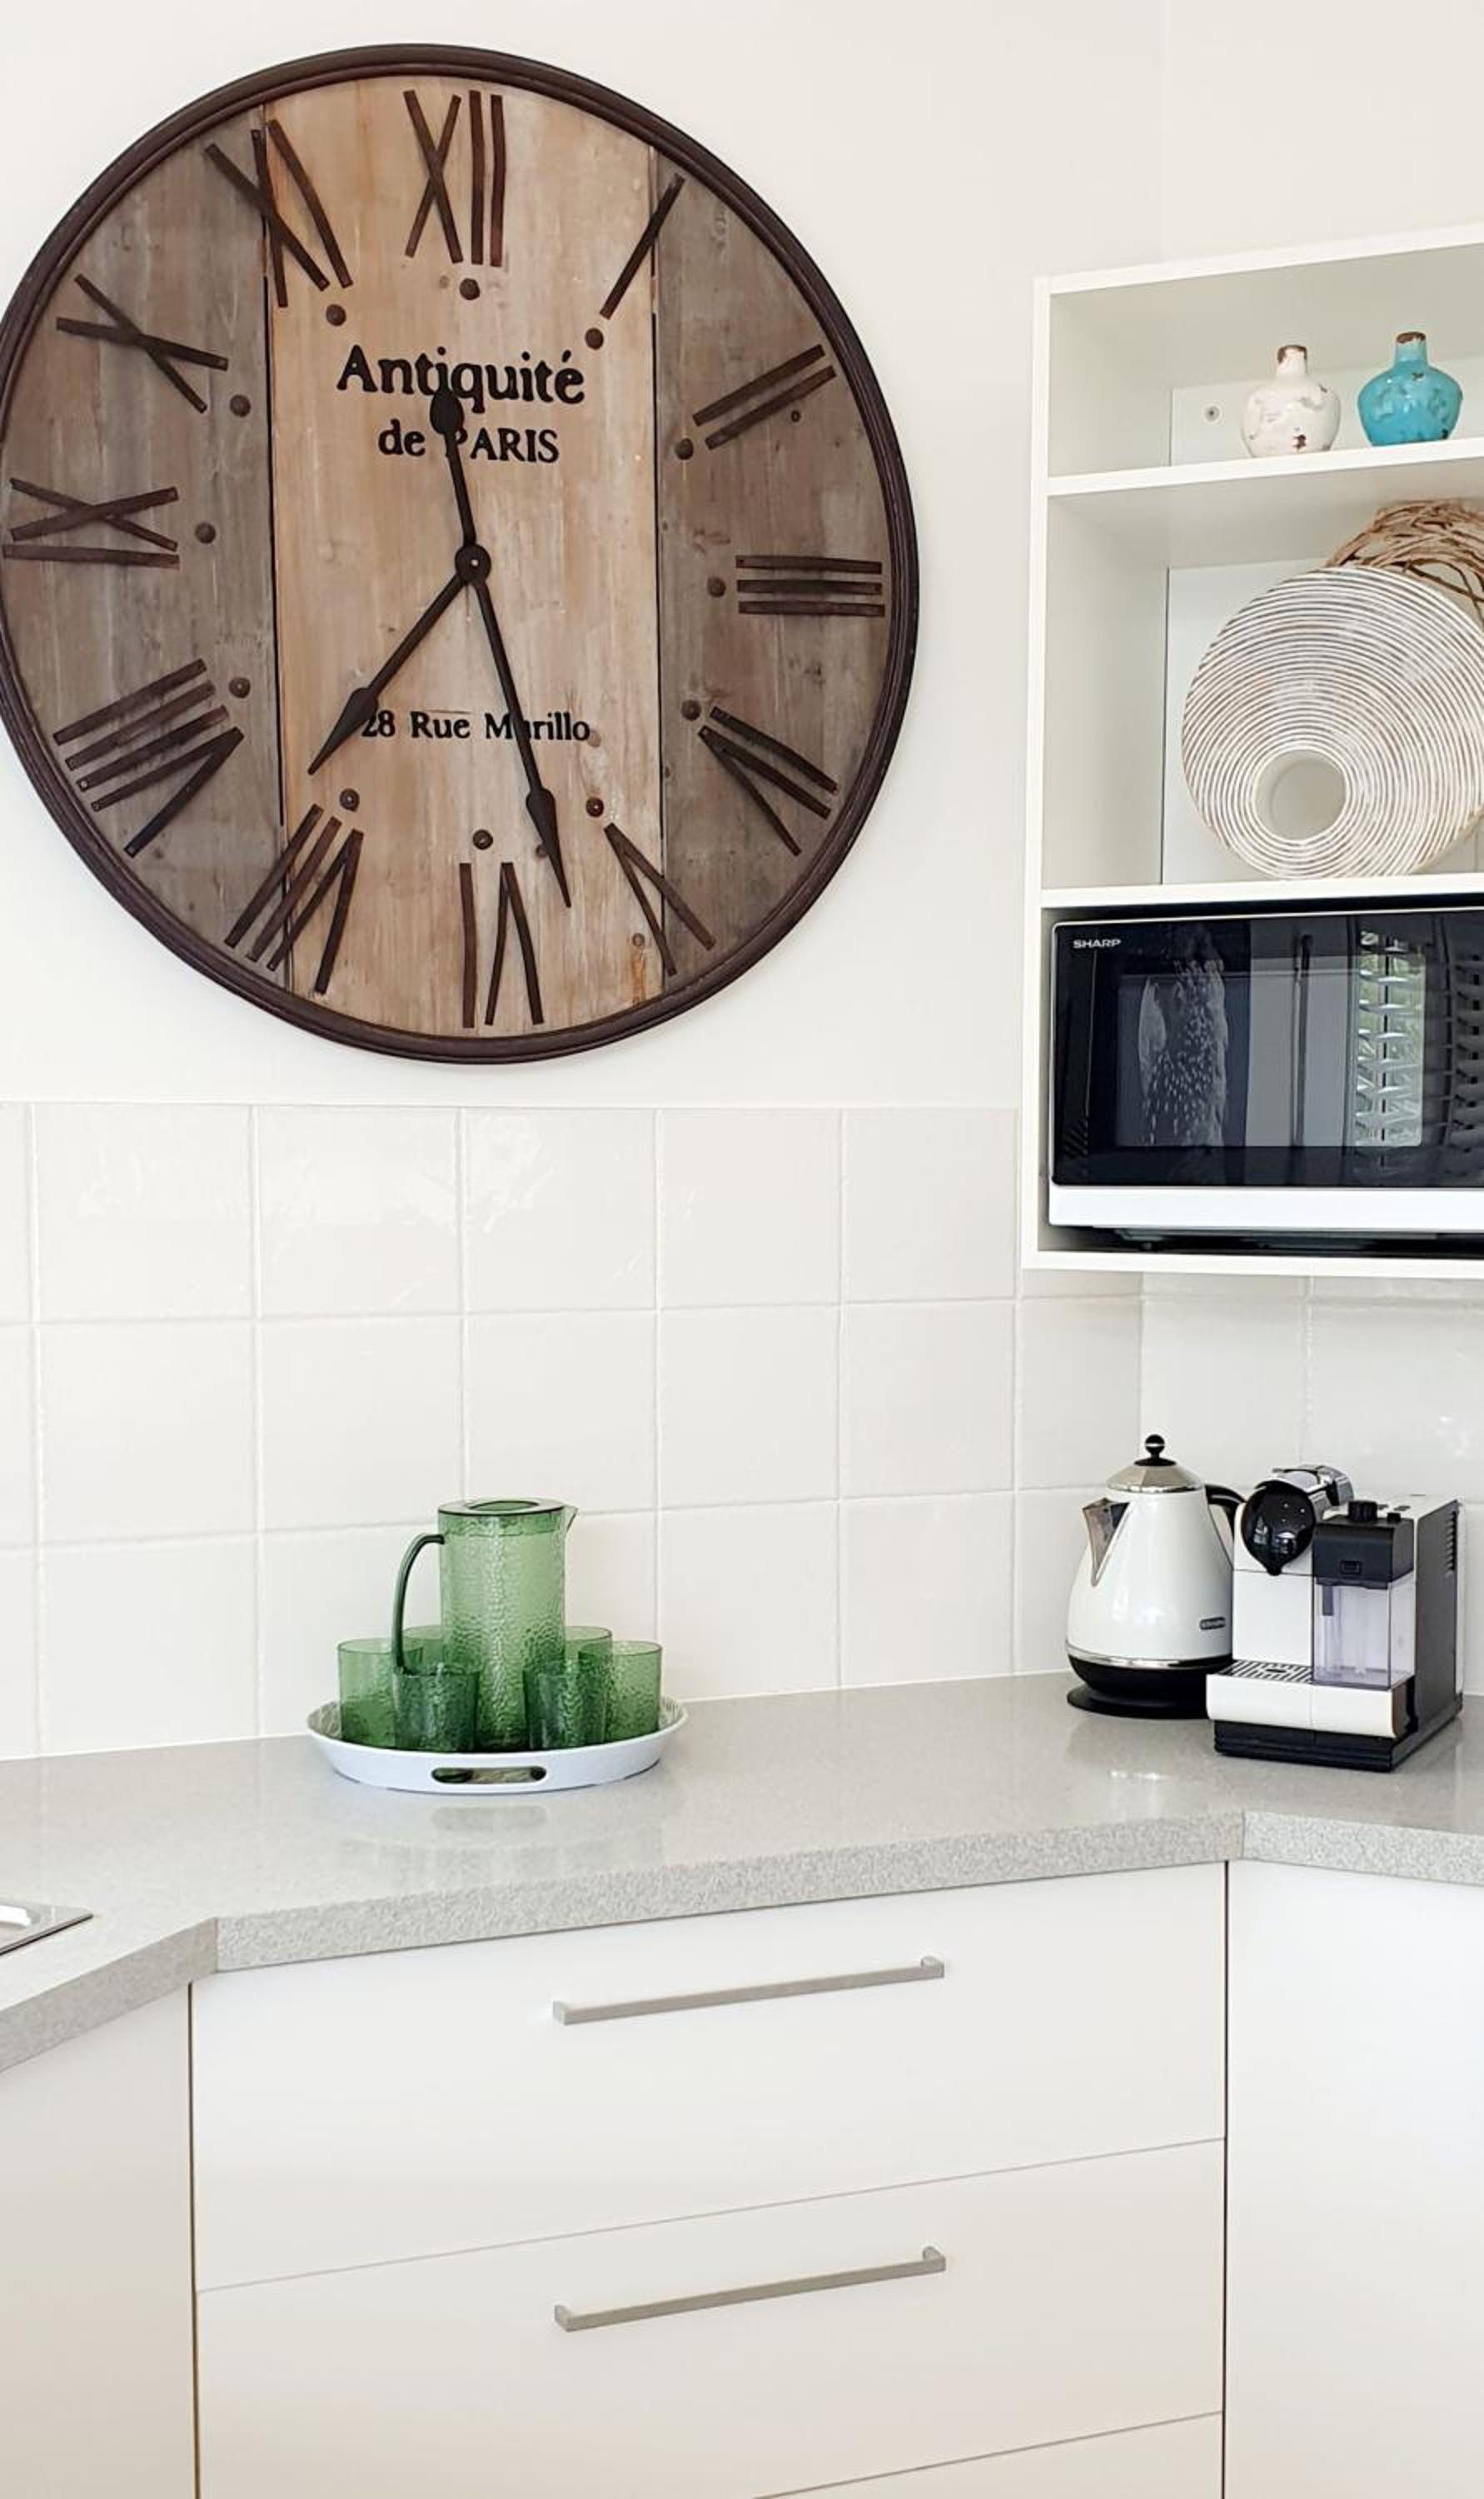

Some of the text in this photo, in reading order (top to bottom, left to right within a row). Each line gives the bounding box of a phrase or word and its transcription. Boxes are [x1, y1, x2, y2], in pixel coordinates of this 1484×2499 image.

[403, 89, 504, 267] XII
[205, 119, 353, 308] XI
[56, 274, 230, 414] X
[336, 344, 585, 414] Antiquité
[377, 418, 426, 456] de
[736, 554, 885, 617] III
[410, 711, 471, 739] Rue
[1073, 938, 1122, 949] SHARP
